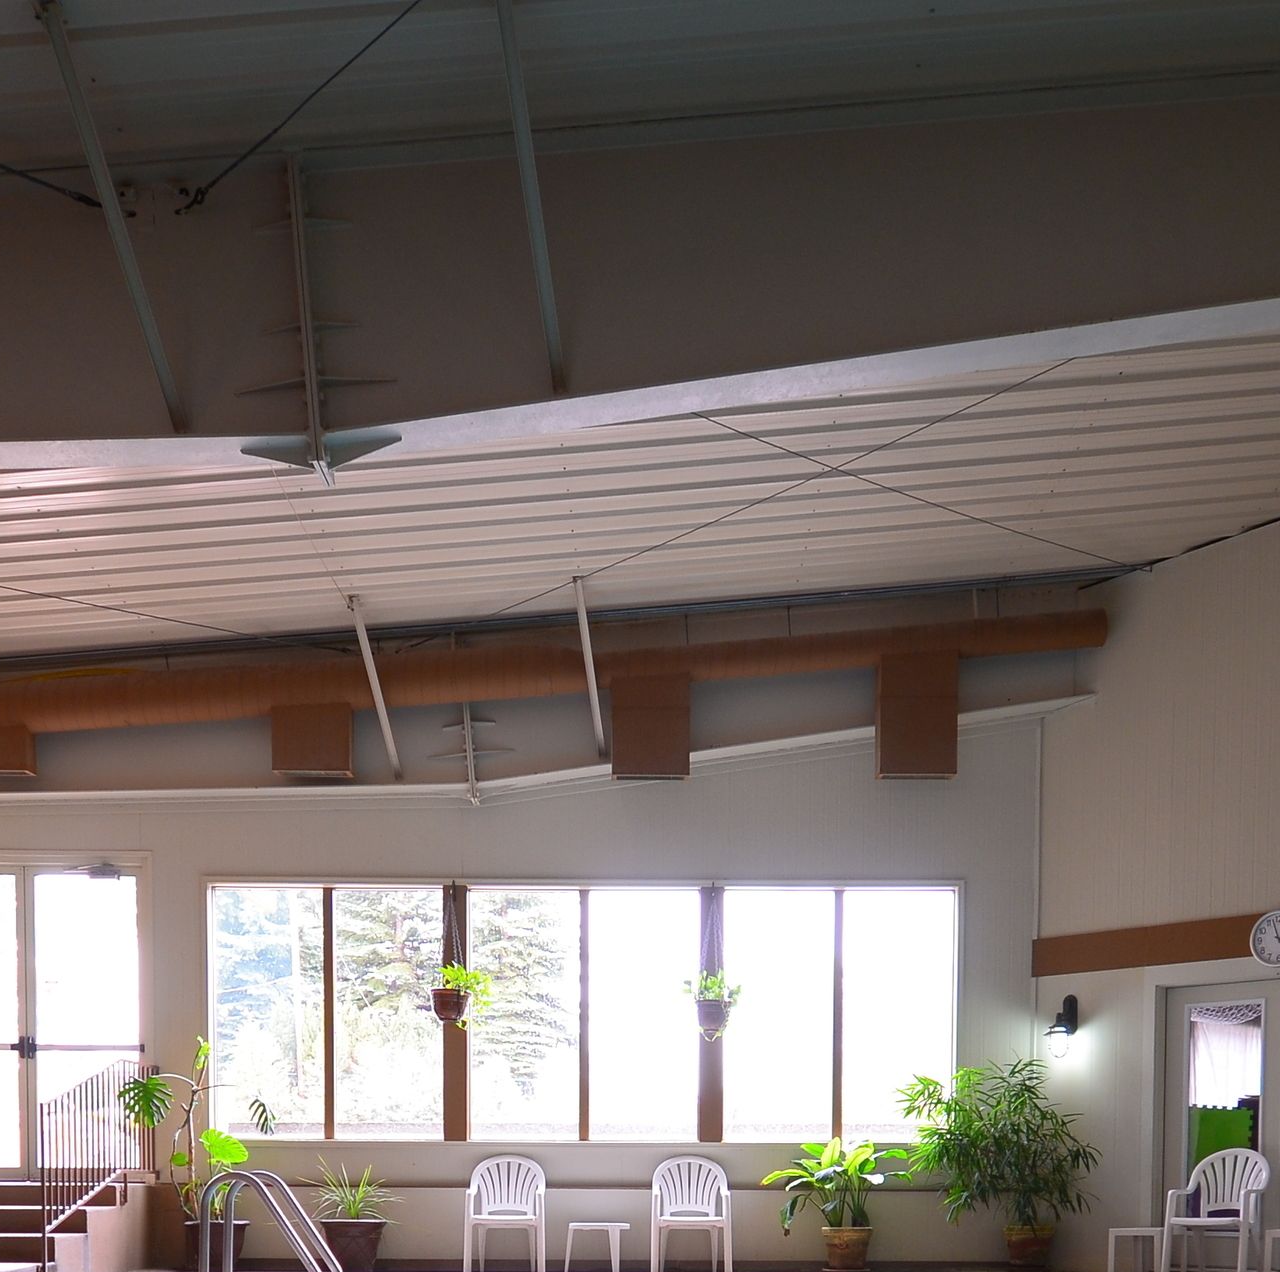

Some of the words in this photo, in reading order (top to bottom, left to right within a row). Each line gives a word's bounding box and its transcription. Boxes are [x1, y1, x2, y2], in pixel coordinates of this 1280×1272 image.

[1257, 936, 1263, 945] 9
[1267, 953, 1272, 961] 7
[1276, 954, 1280, 962] 6
